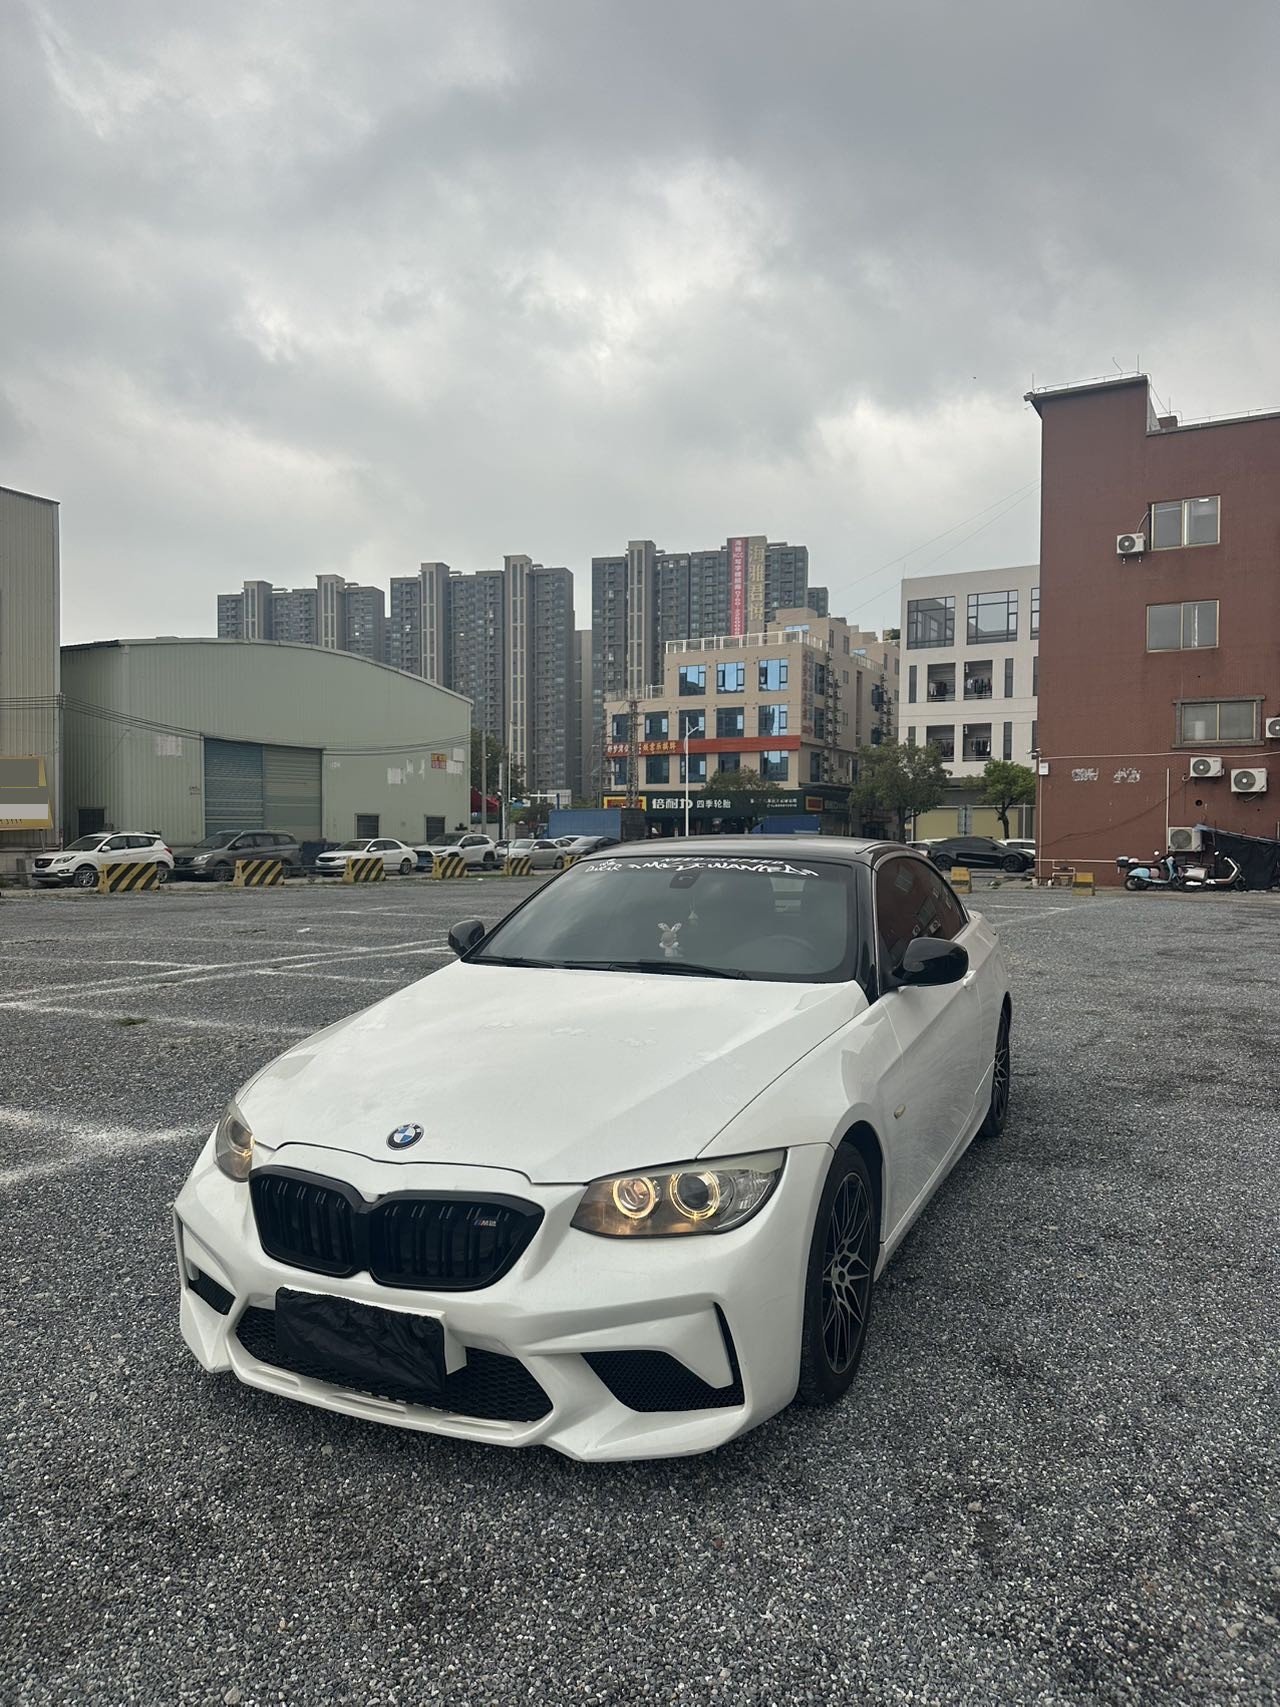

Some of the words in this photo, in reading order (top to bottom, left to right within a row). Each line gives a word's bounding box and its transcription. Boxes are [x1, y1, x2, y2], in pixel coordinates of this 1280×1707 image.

[749, 545, 765, 620] 海雅君悦
[652, 798, 693, 809] 倍耐力
[696, 799, 731, 809] 四季轮胎
